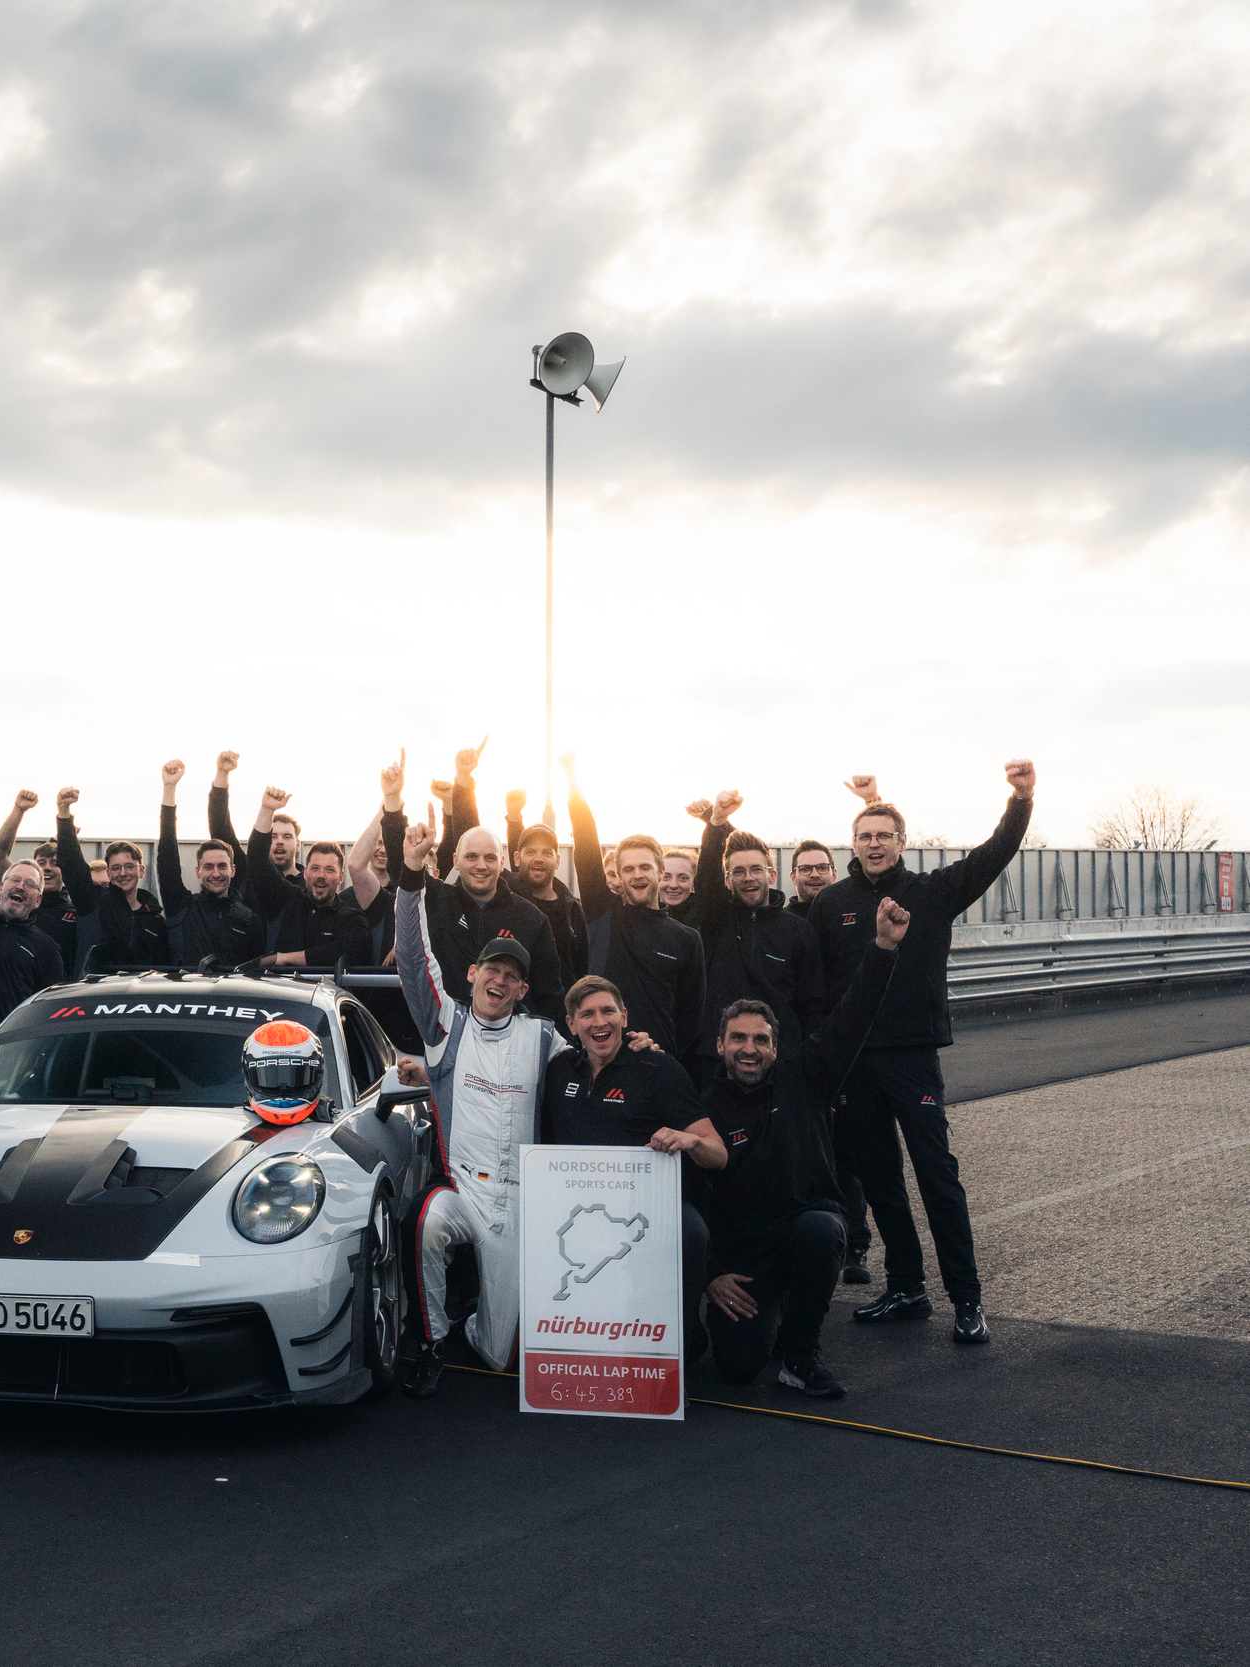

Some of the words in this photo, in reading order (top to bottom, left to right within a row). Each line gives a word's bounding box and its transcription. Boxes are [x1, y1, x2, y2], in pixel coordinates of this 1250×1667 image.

[94, 1004, 284, 1021] MANTHEY
[249, 1058, 320, 1069] PORSCHE
[464, 1082, 497, 1098] MOTORSPORT
[465, 1073, 523, 1091] PORSCHE
[549, 1161, 651, 1174] NORDSCHLEIFE
[565, 1180, 605, 1189] SPORTS
[607, 1180, 635, 1190] CARS
[15, 1302, 86, 1331] 5046
[537, 1316, 666, 1342] nürburgring
[538, 1363, 600, 1377] OFFICIAL
[603, 1365, 630, 1378] LAP
[632, 1367, 666, 1380] TIME
